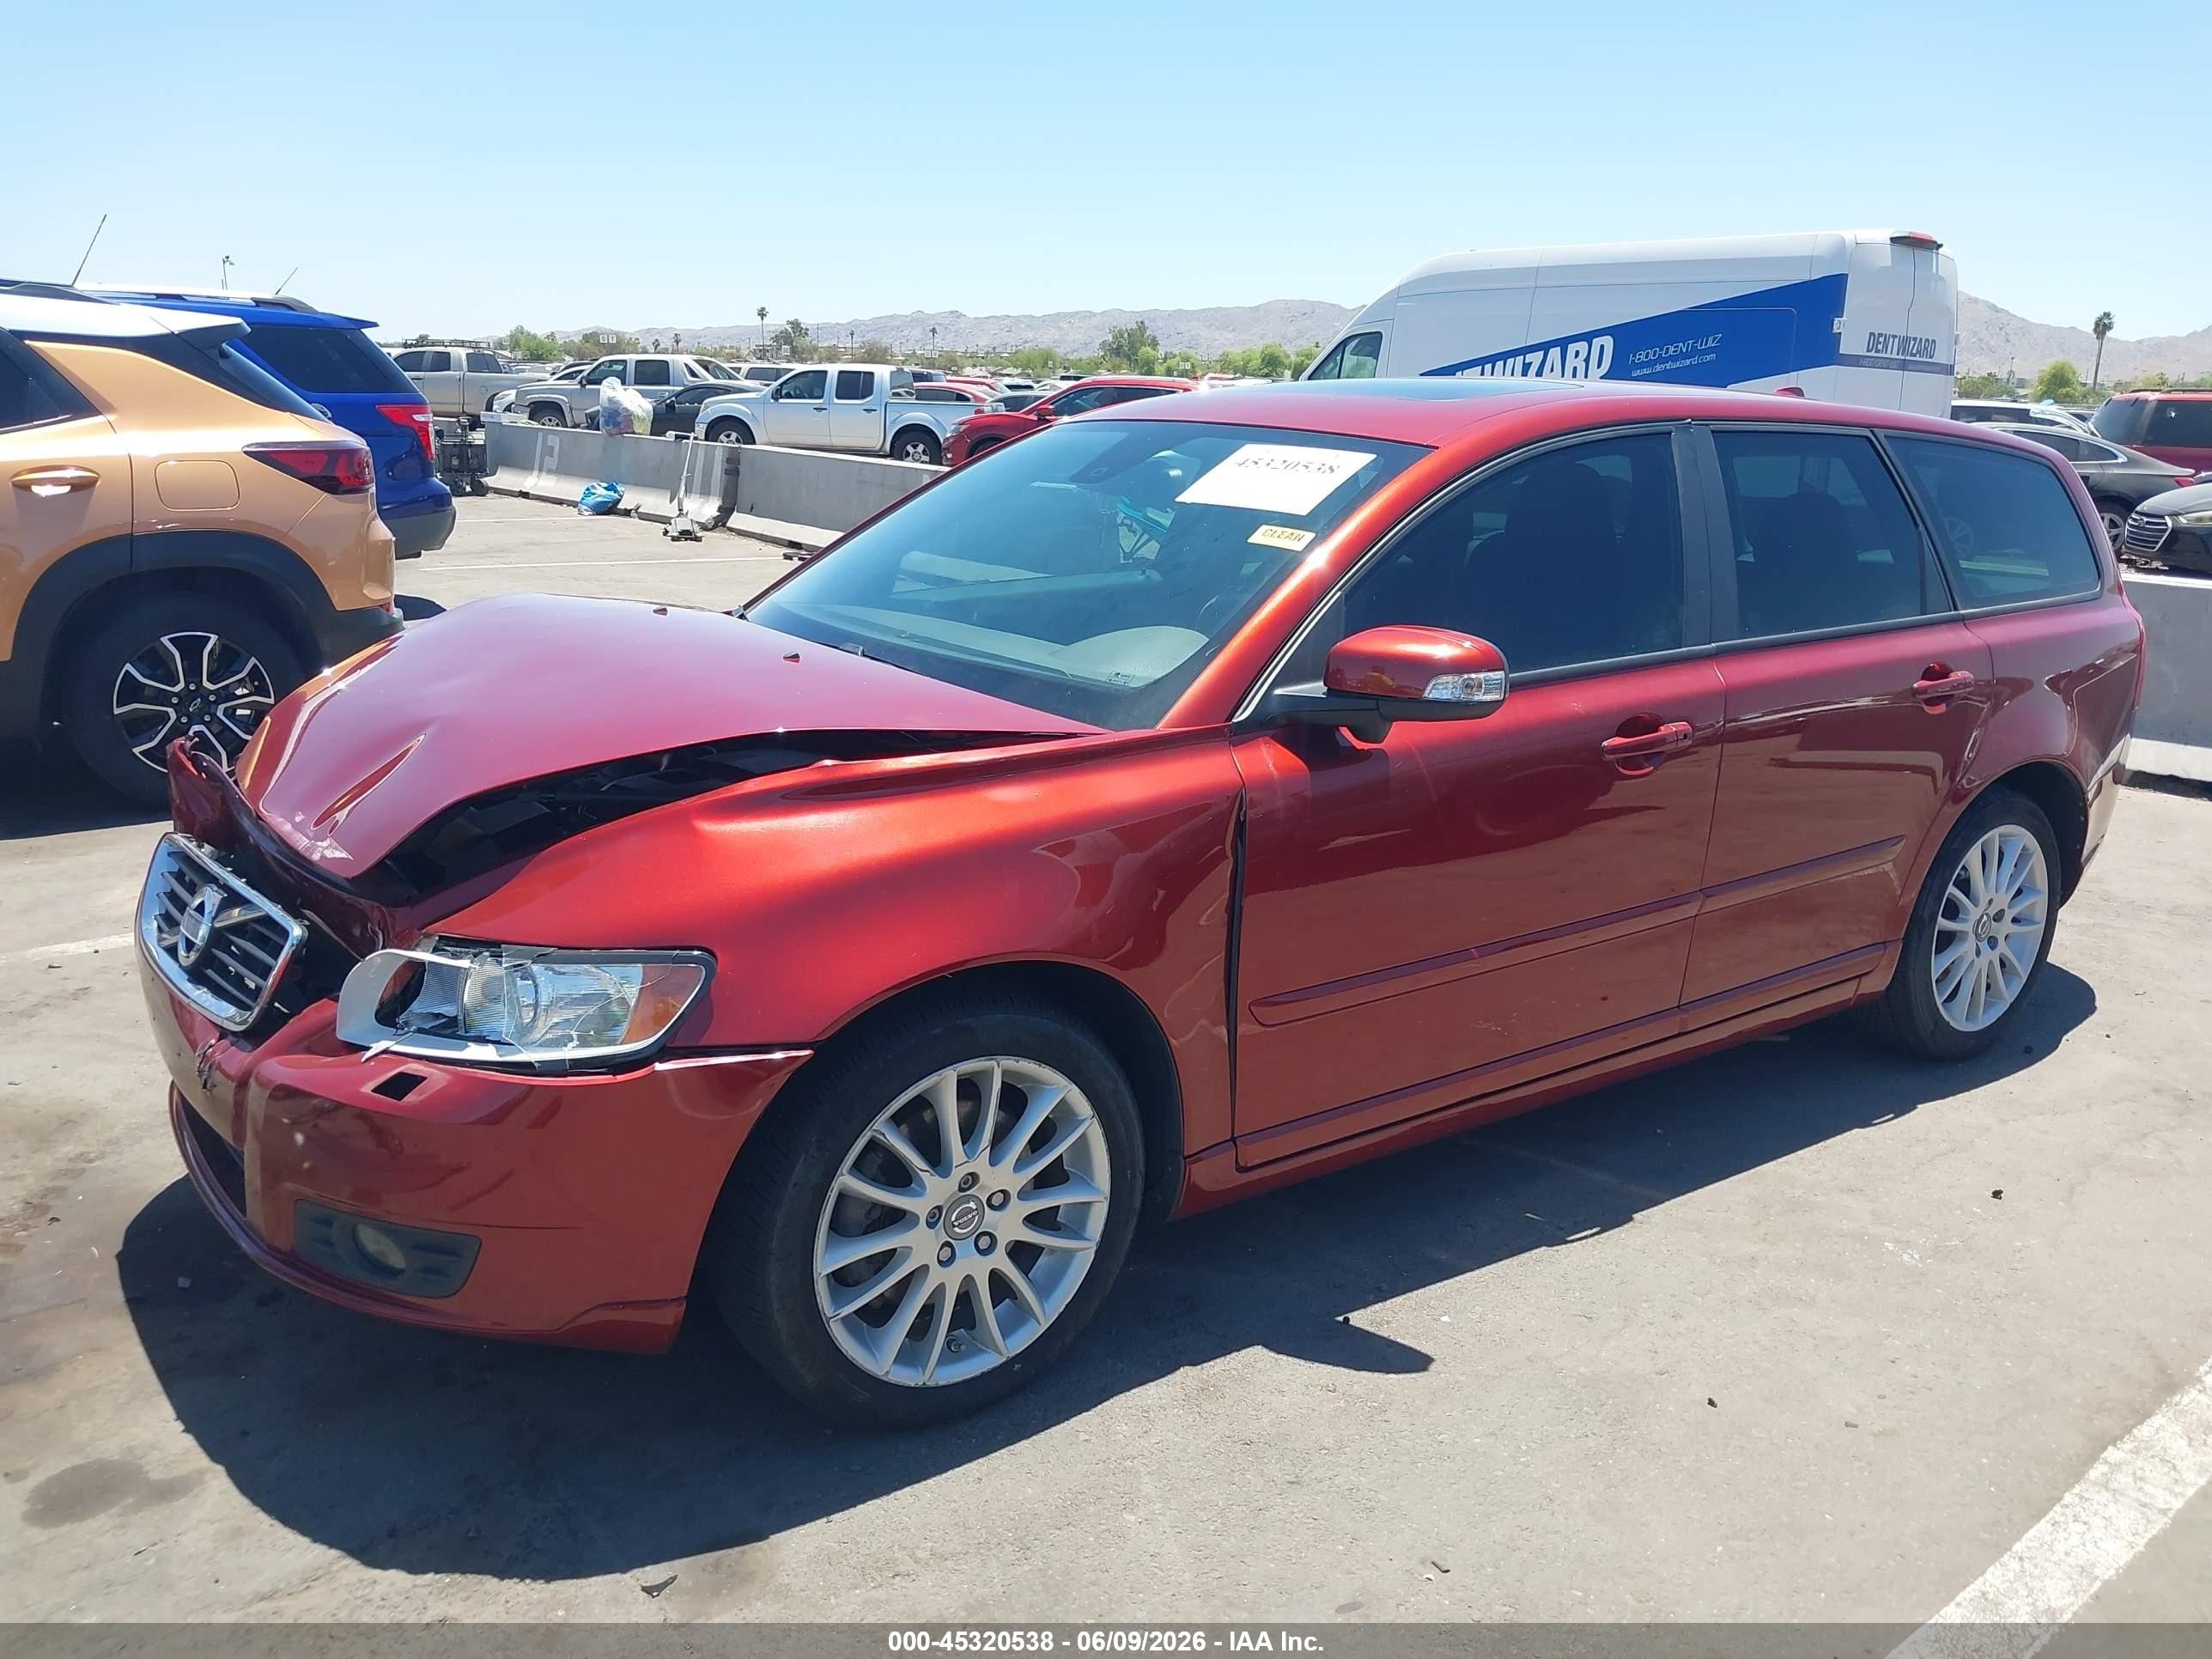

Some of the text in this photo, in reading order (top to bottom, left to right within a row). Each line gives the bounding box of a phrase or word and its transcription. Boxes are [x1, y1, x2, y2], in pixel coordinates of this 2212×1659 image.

[1629, 334, 1723, 365] 1-800-DENT-WIZ
[1632, 353, 1716, 377] www.dentwizard.com
[1261, 529, 1305, 542] CLEAN
[953, 1210, 978, 1226] VOLVO
